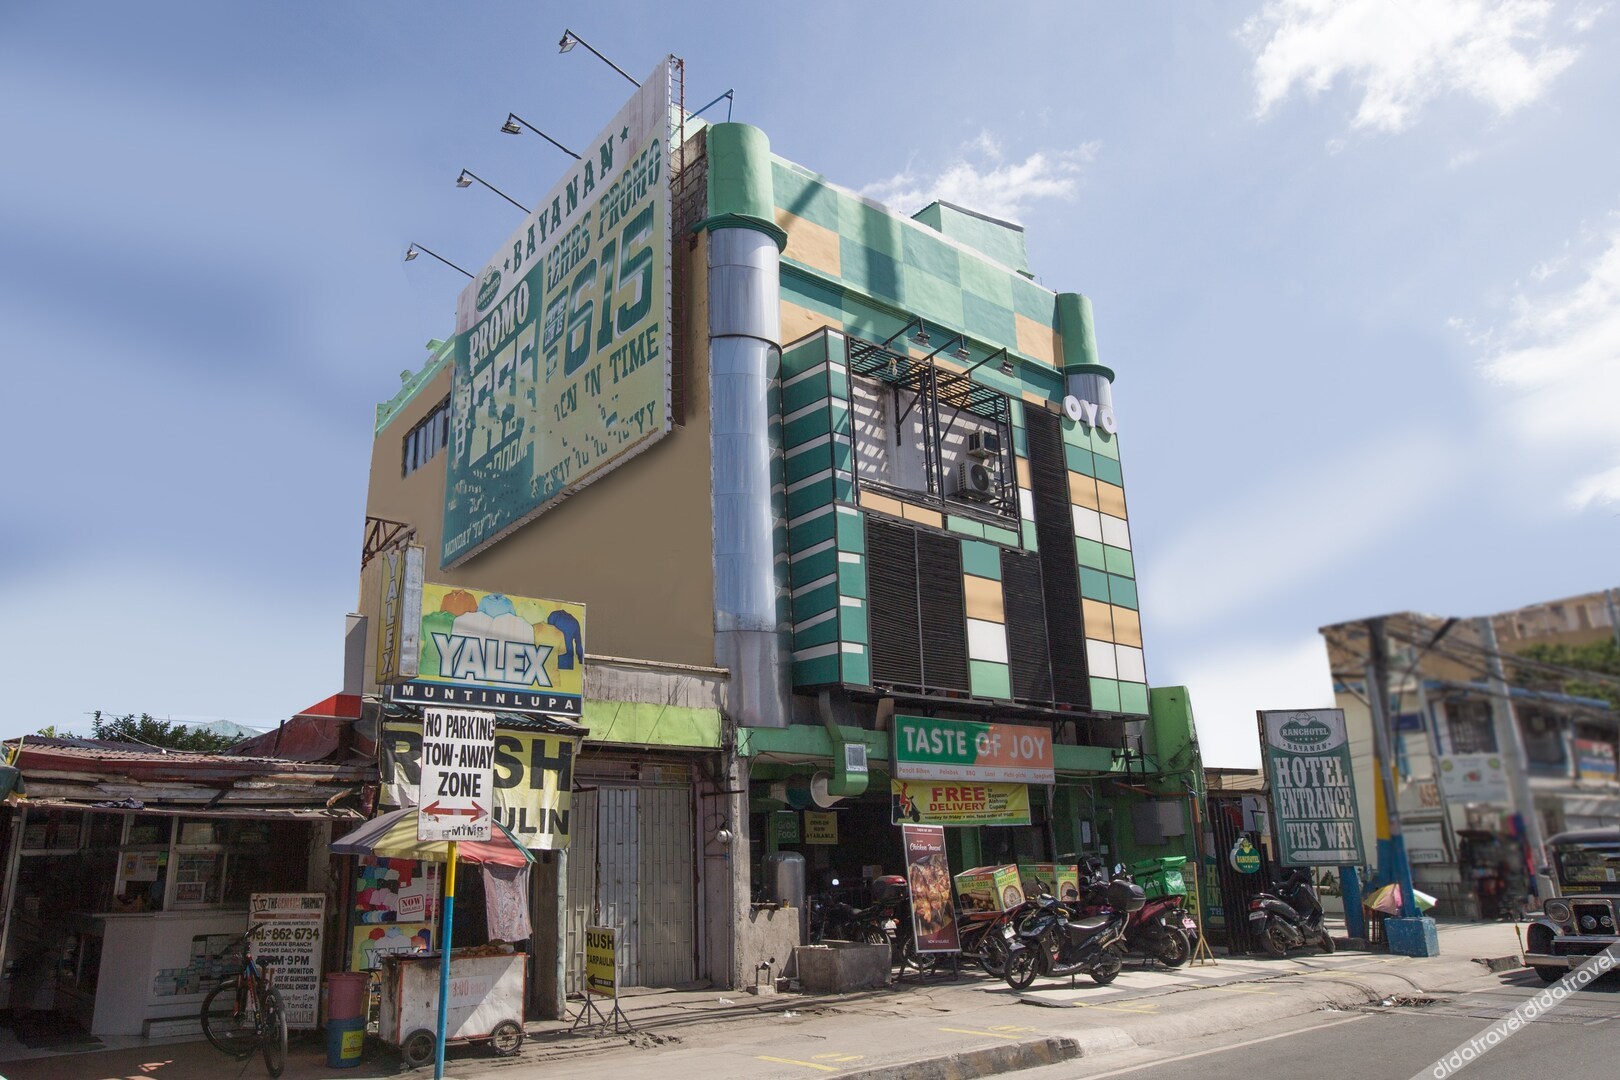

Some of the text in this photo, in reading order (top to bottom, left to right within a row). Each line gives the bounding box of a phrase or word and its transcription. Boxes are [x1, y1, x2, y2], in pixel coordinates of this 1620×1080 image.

[512, 134, 614, 274] BAYANAN
[598, 138, 662, 242] PROMO
[468, 281, 530, 376] PROMO
[609, 322, 659, 385] TIME
[1063, 395, 1117, 434] OYO
[431, 632, 553, 688] YALEX
[402, 684, 574, 710] MUNTINLUPA
[425, 713, 495, 742] NO PARKING
[1282, 727, 1329, 736] RANCHOTEL
[903, 726, 1045, 760] TASTE OF JOY
[1287, 743, 1327, 752] BAYANAN
[383, 730, 573, 792] RSH
[1273, 756, 1348, 788] HOTEL
[437, 771, 481, 798] ZONE
[931, 787, 986, 802] FREE
[929, 802, 986, 811] DELIVERY
[1278, 787, 1354, 819] ENTRANCE
[1286, 822, 1355, 850] THIS WAY
[402, 897, 421, 907] NOW
[586, 932, 615, 950] RUSH
